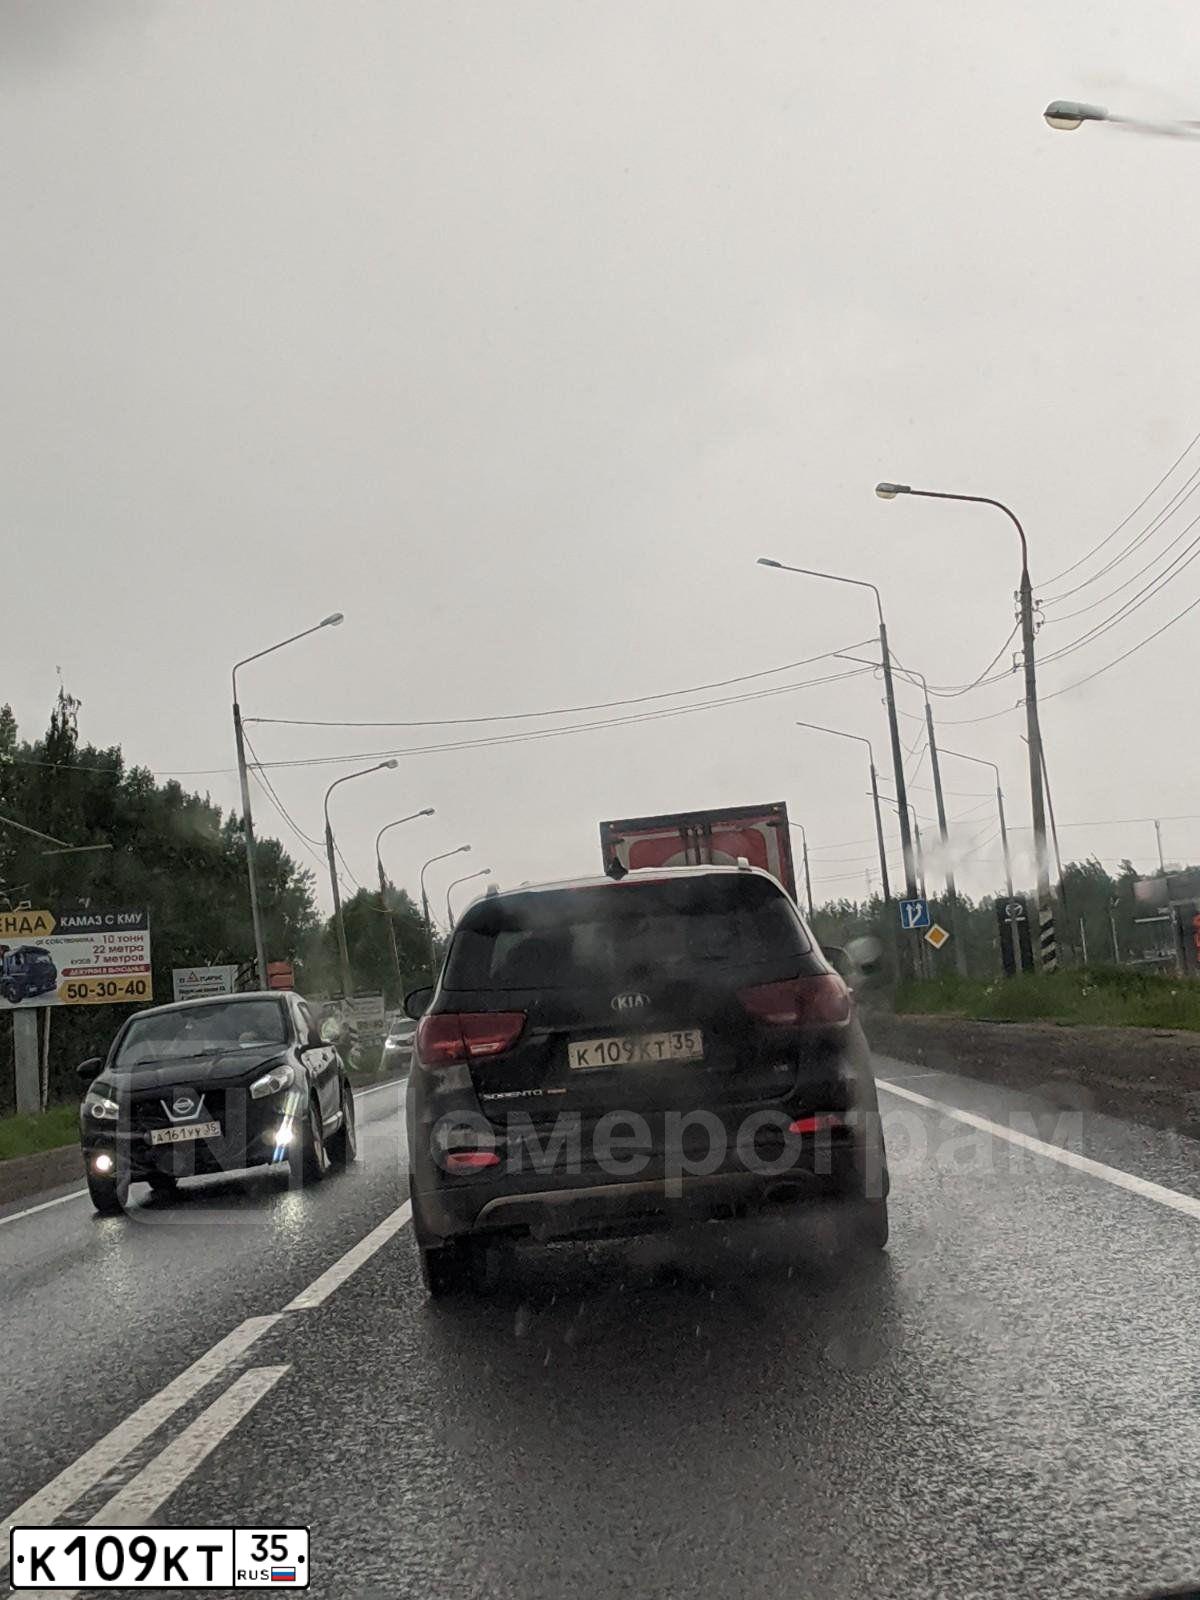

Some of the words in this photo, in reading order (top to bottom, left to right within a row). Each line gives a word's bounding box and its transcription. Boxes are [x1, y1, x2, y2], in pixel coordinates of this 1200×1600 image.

[60, 916, 102, 927] КАМАЗ
[104, 914, 114, 925] С
[117, 912, 143, 925] КМУ
[102, 935, 115, 943] 10
[118, 934, 144, 943] тонн
[92, 946, 106, 954] 22
[108, 944, 144, 954] метра
[94, 955, 101, 964] 7
[103, 954, 145, 963] метров
[66, 979, 147, 999] 50-30-40
[617, 995, 644, 1009] KIA
[672, 1033, 694, 1051] 35
